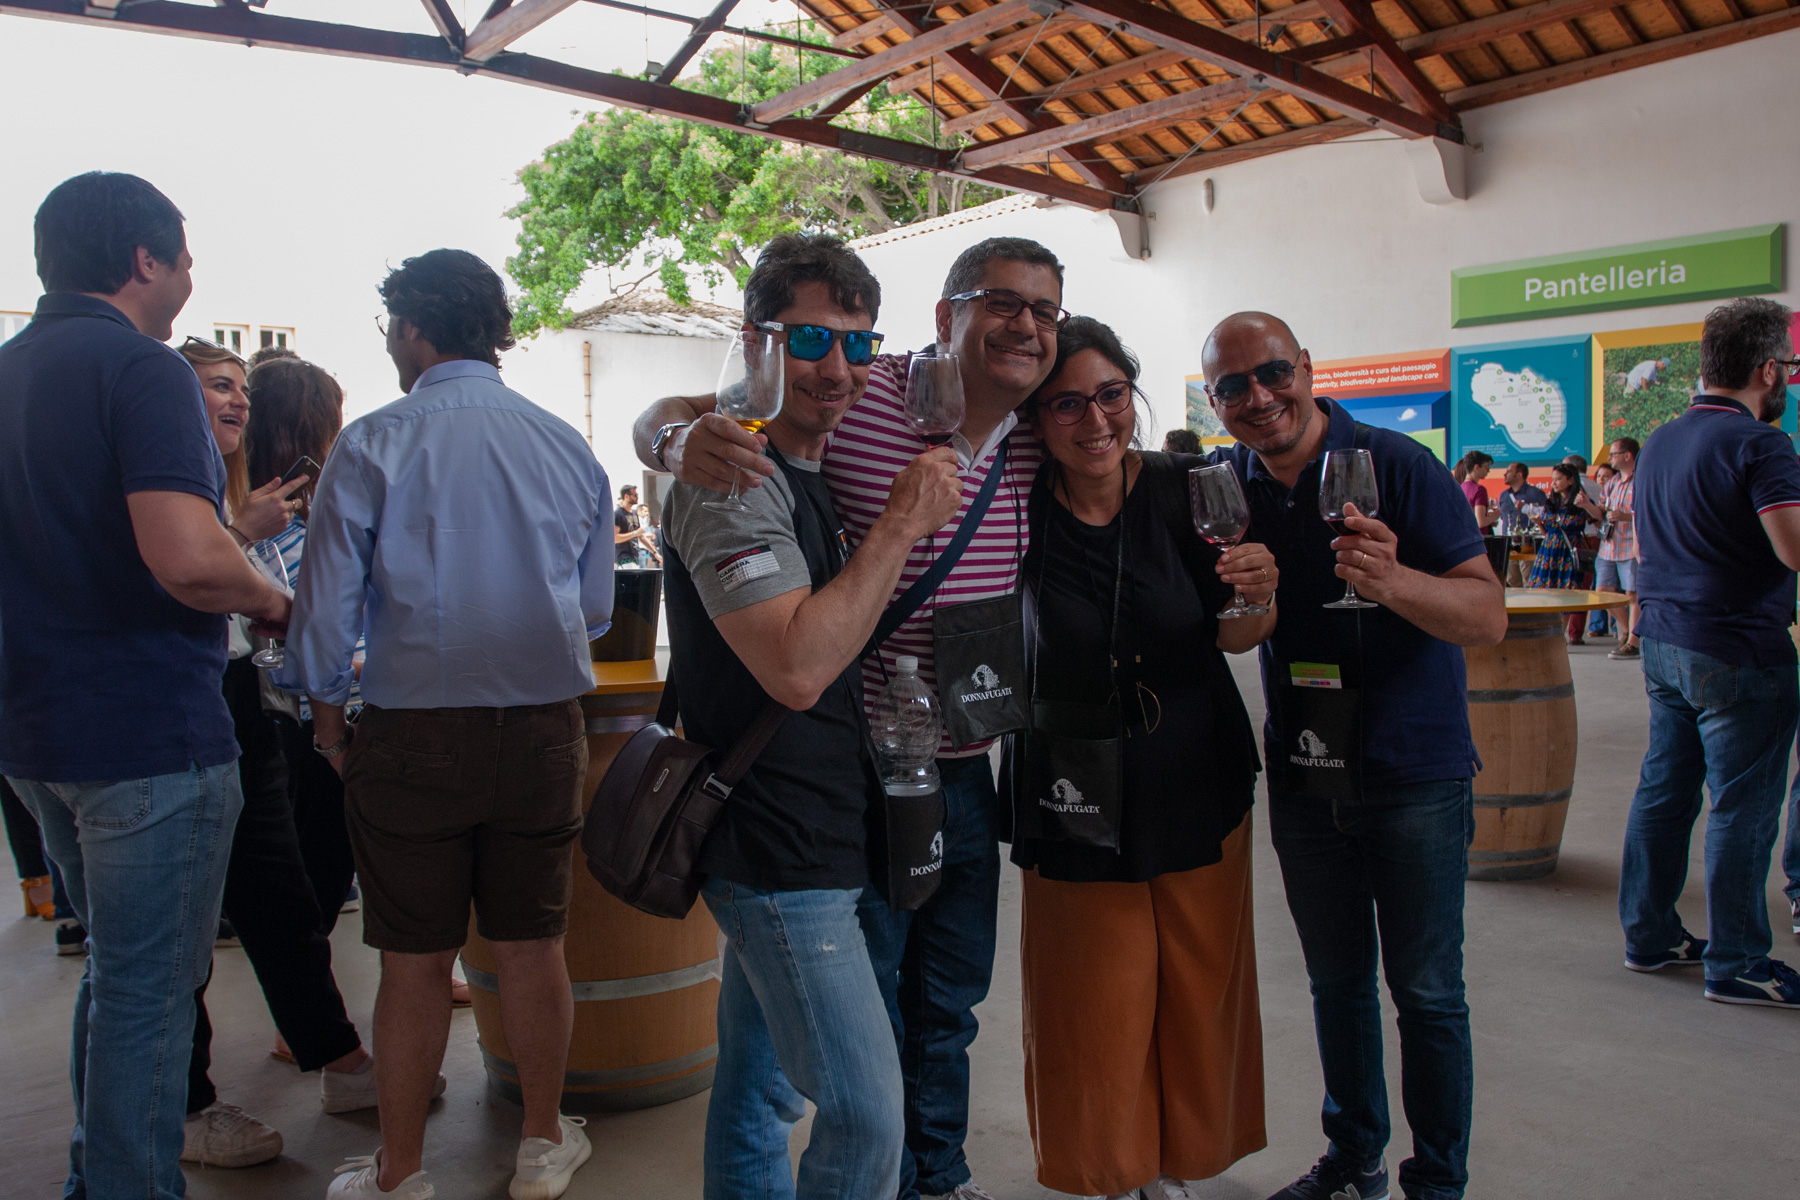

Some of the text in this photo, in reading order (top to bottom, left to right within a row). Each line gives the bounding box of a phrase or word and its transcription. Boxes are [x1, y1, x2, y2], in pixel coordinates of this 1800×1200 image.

[1525, 260, 1686, 301] Pantelleria
[1333, 369, 1369, 378] biodiversità
[1402, 362, 1436, 372] paesaggio
[1340, 377, 1376, 387] biodiversity
[1377, 375, 1389, 383] and
[1390, 373, 1423, 383] landscape
[720, 560, 750, 578] CARRERA
[721, 573, 735, 583] CUP
[961, 687, 1013, 703] DONNAFUGATA
